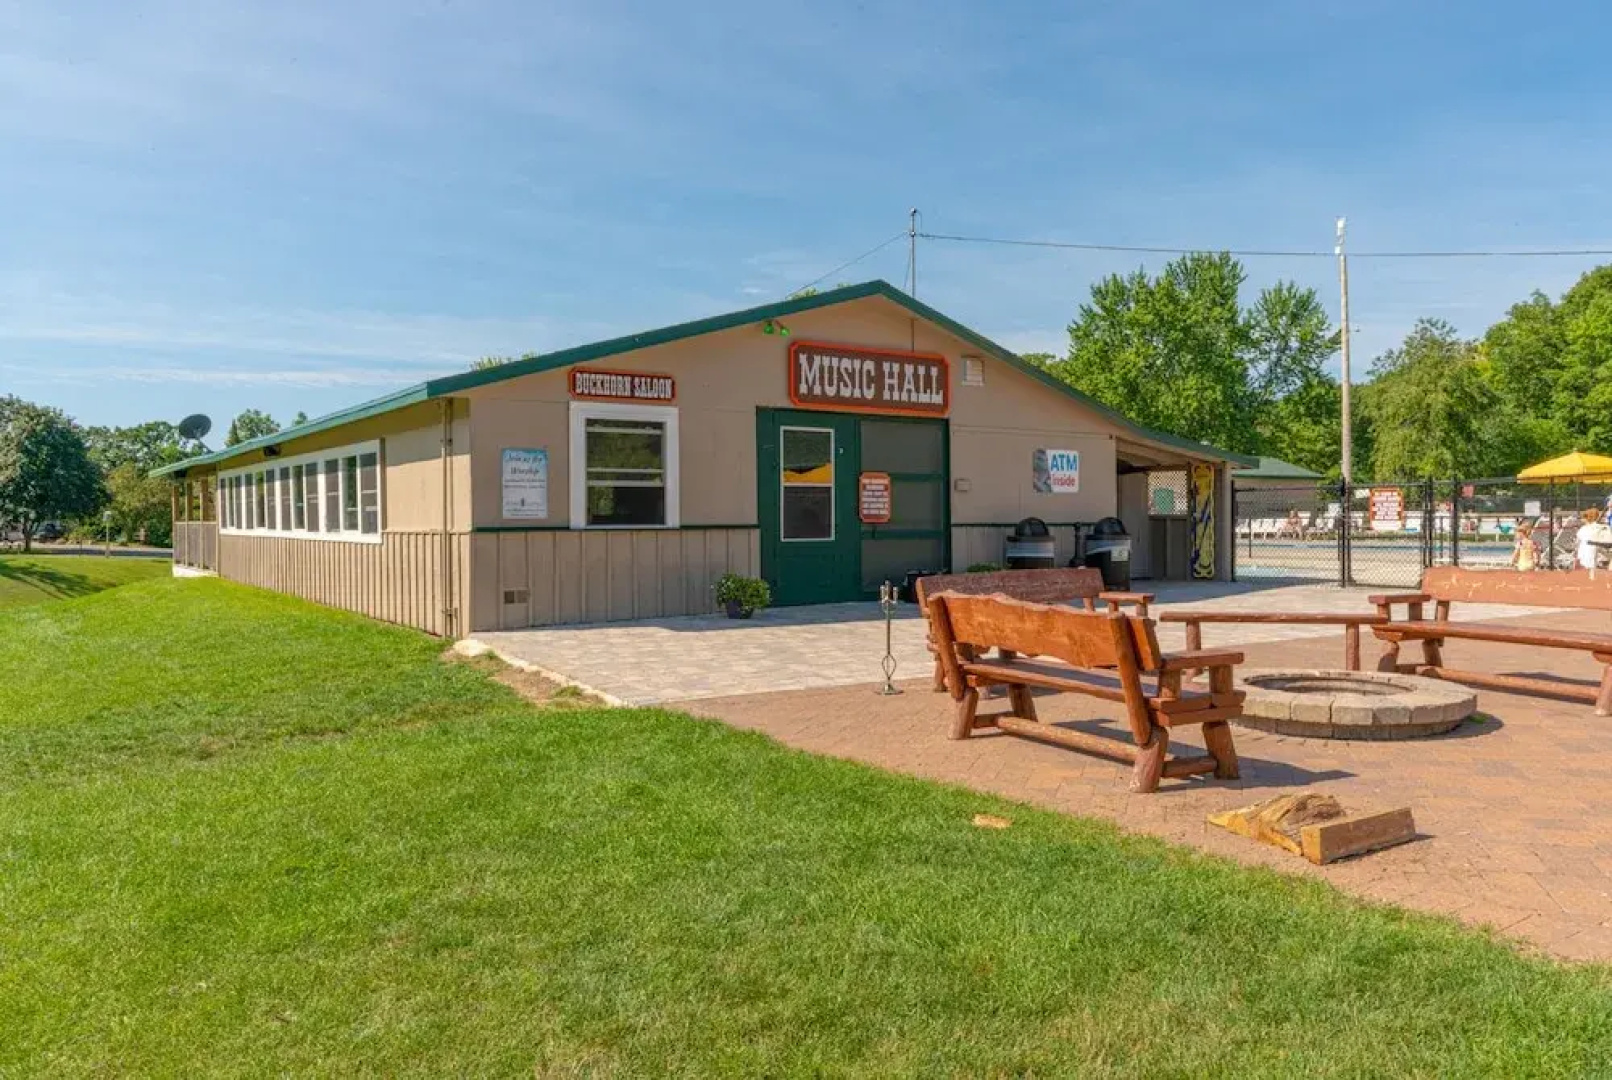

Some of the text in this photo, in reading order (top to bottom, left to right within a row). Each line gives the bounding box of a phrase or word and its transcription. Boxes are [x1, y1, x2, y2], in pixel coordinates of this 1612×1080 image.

[575, 373, 672, 398] BUCKHORN SALOON
[799, 353, 943, 404] MUSIC HALL
[1050, 453, 1078, 472] ATM
